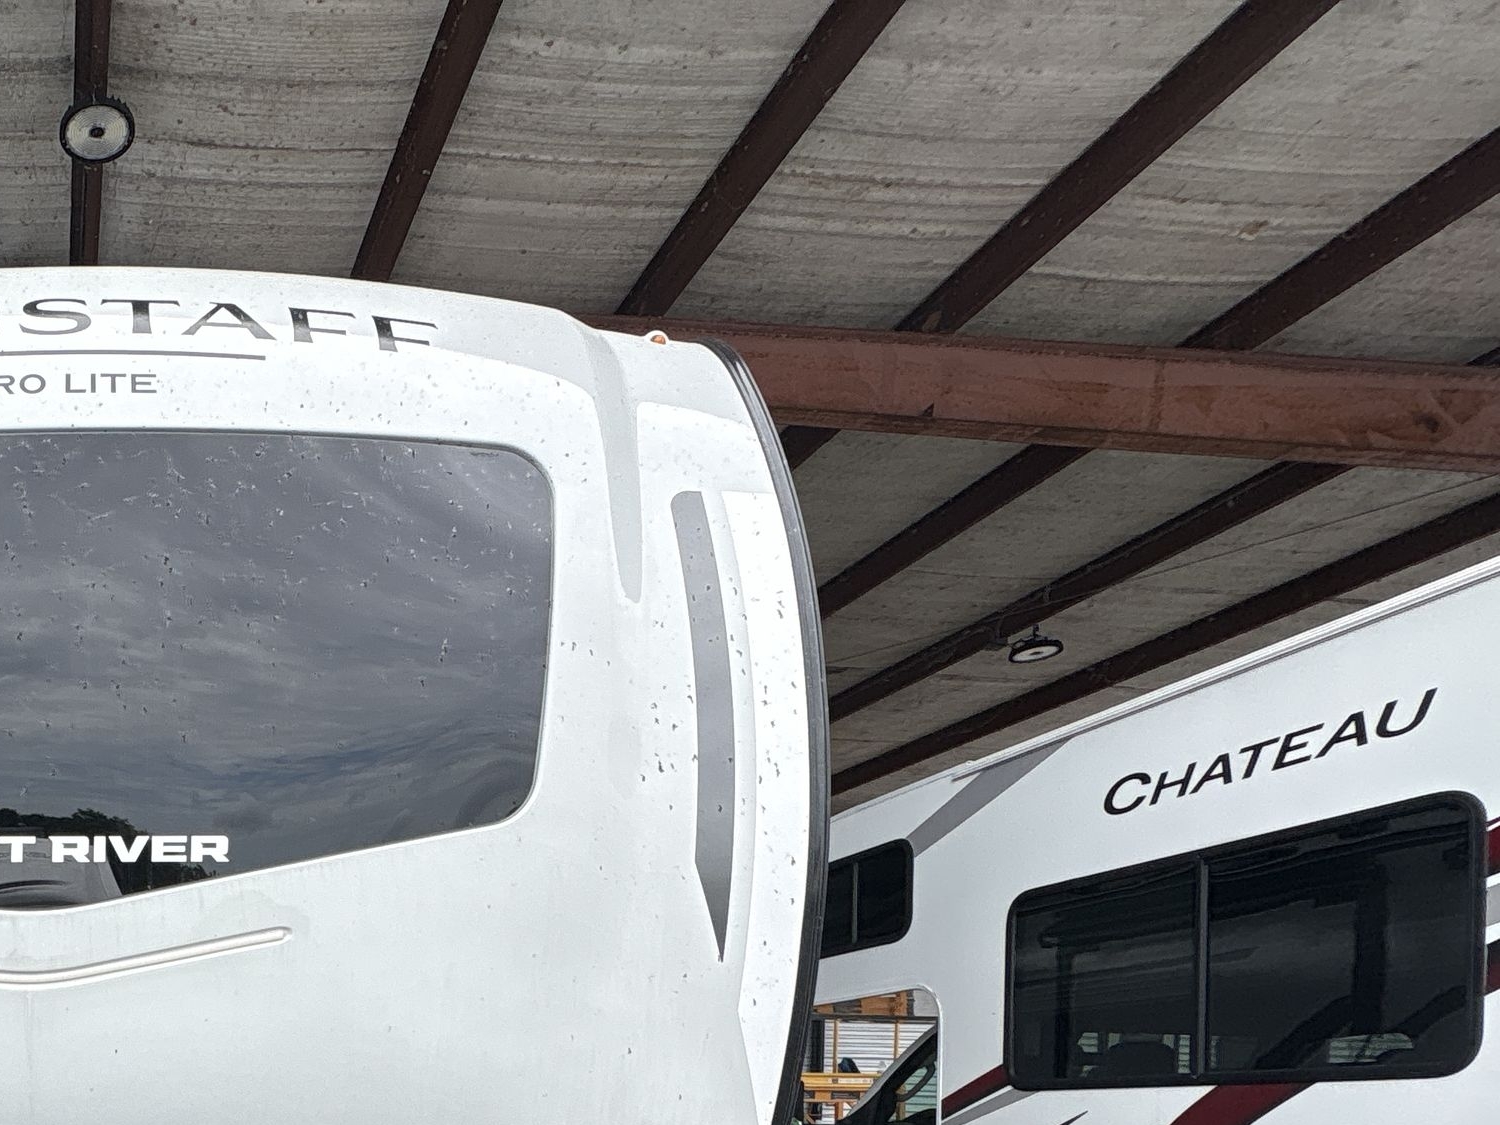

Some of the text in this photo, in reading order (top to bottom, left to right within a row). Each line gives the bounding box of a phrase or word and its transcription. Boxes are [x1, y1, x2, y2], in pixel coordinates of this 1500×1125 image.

[65, 373, 158, 394] LITE
[1103, 687, 1438, 816] CHATEAU
[48, 835, 230, 863] RIVER
